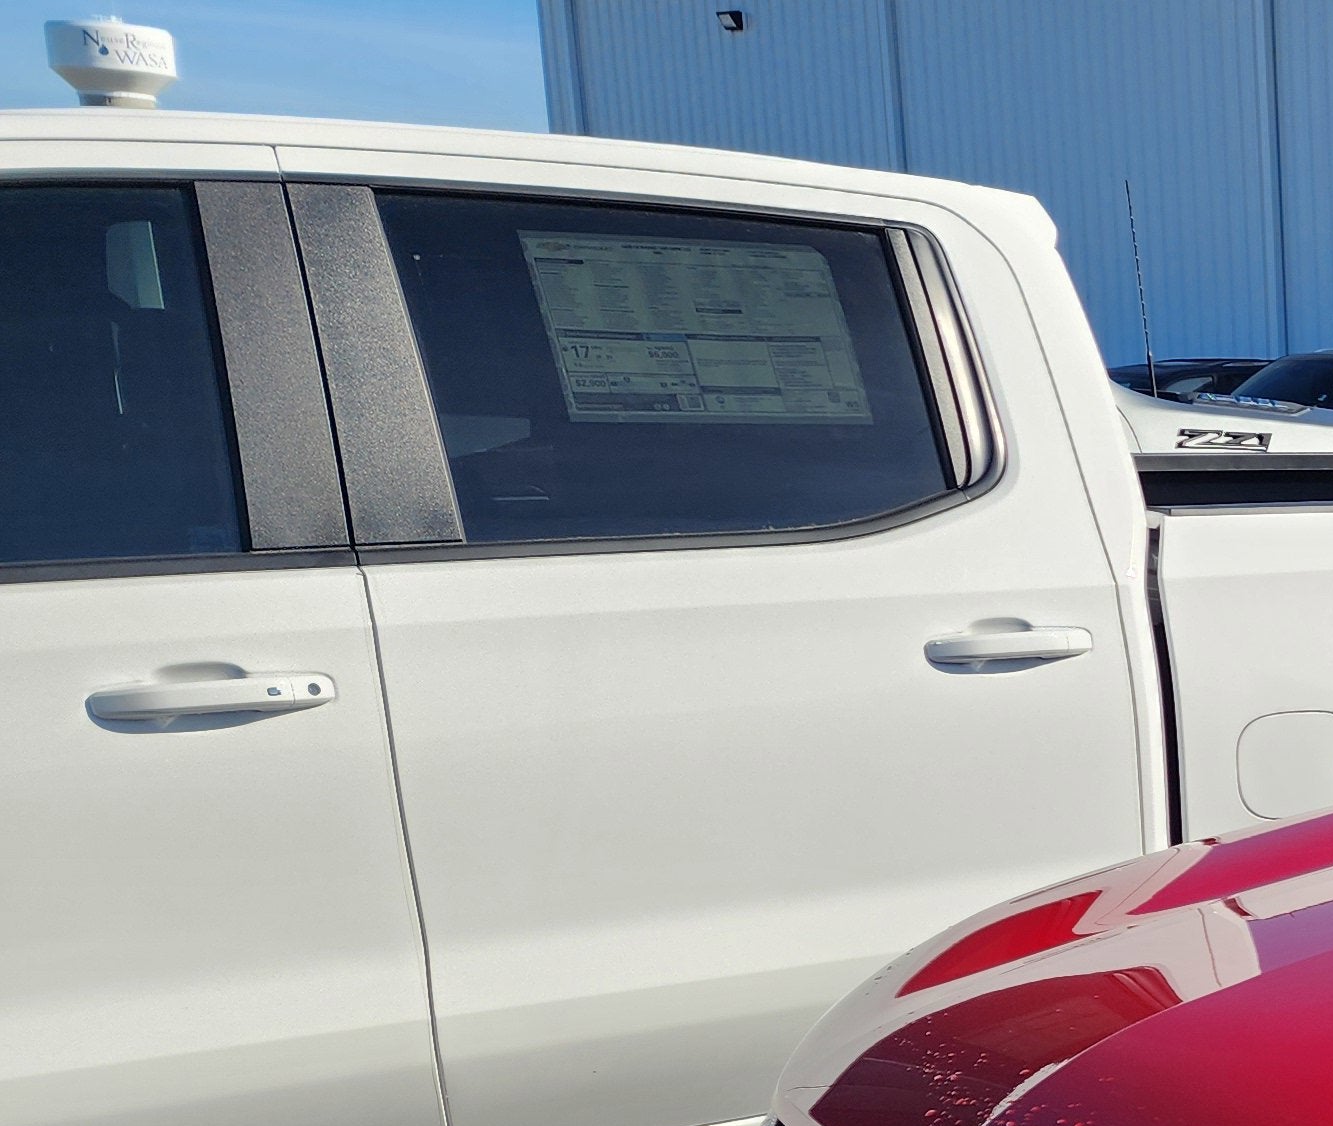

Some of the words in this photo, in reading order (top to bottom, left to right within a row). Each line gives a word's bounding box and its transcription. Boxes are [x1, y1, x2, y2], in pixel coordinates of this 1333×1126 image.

[114, 49, 168, 69] WASA
[571, 345, 589, 358] 17
[1175, 429, 1272, 453] Z71
